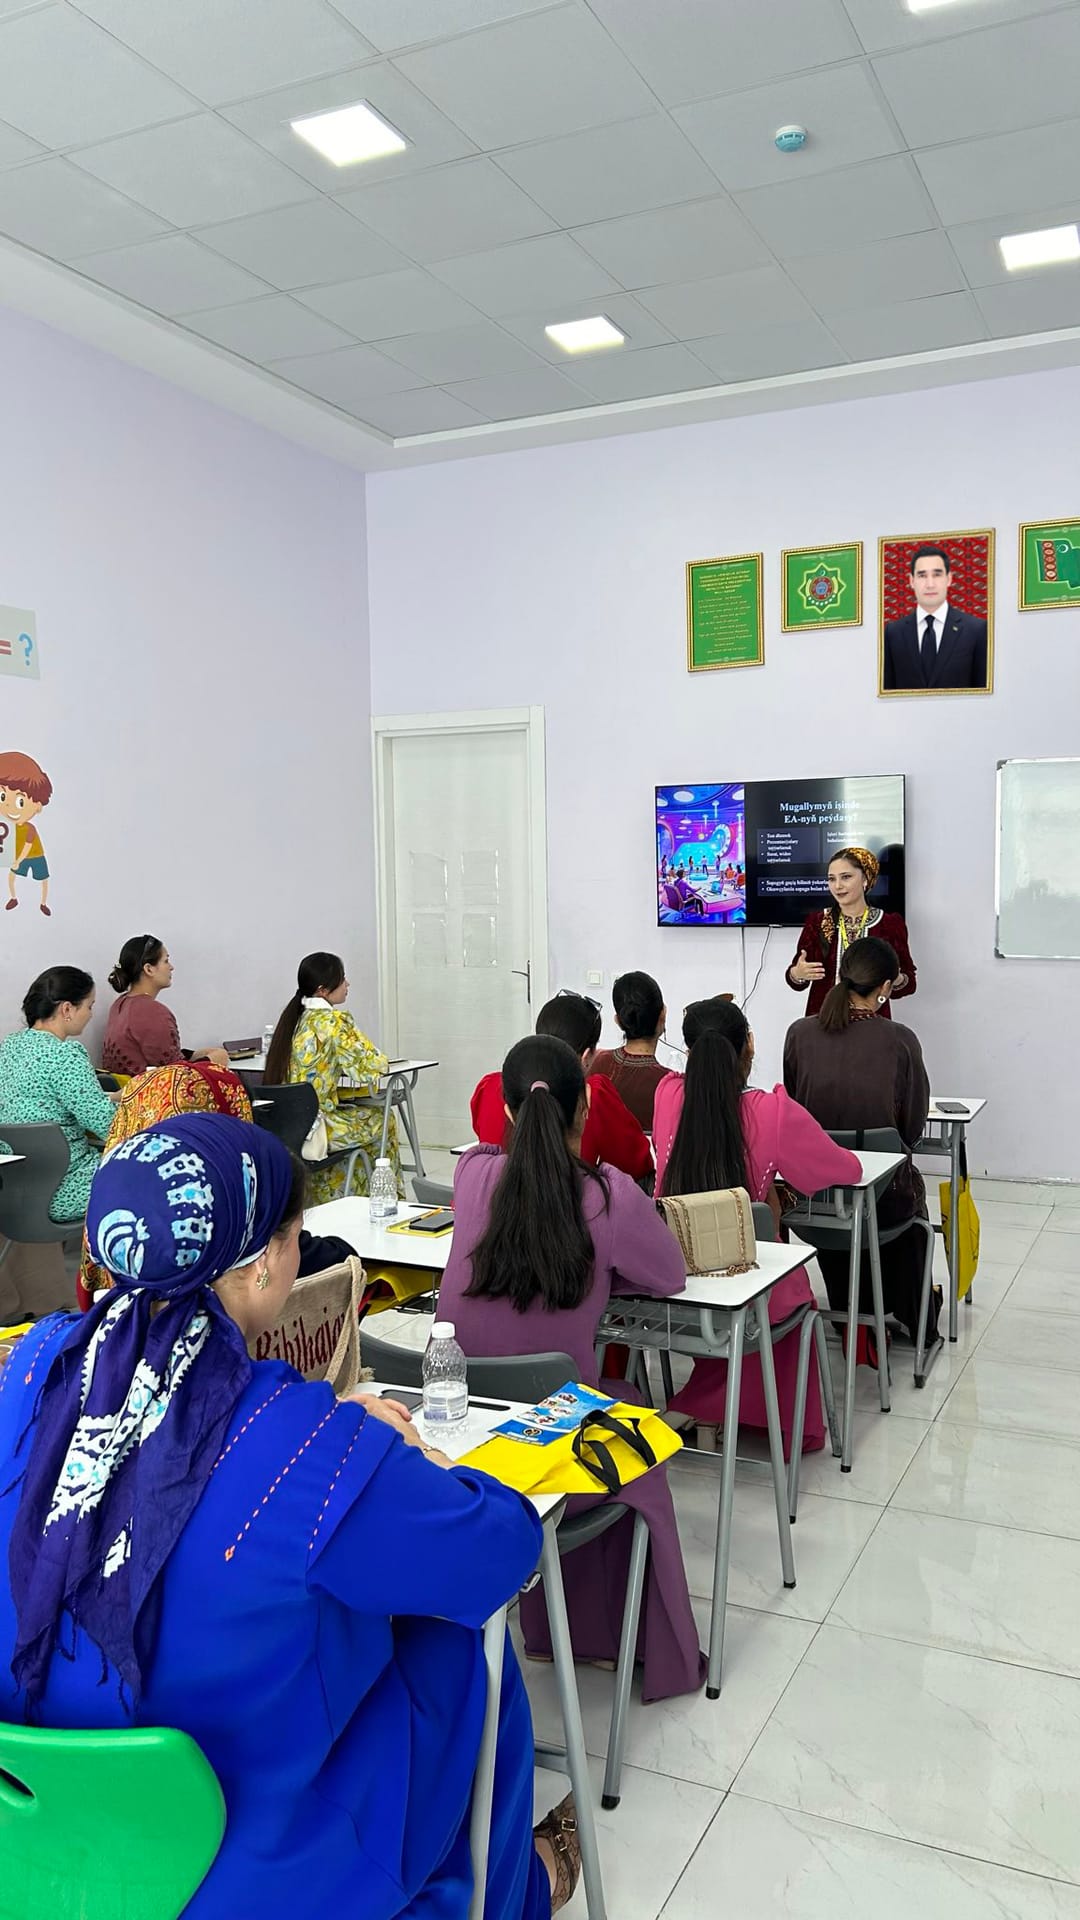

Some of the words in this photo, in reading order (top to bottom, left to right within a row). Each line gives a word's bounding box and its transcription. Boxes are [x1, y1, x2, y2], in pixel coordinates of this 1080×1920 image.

[19, 633, 33, 666] ?
[780, 801, 832, 813] Mugallymyň
[784, 814, 816, 825] EA-nyň
